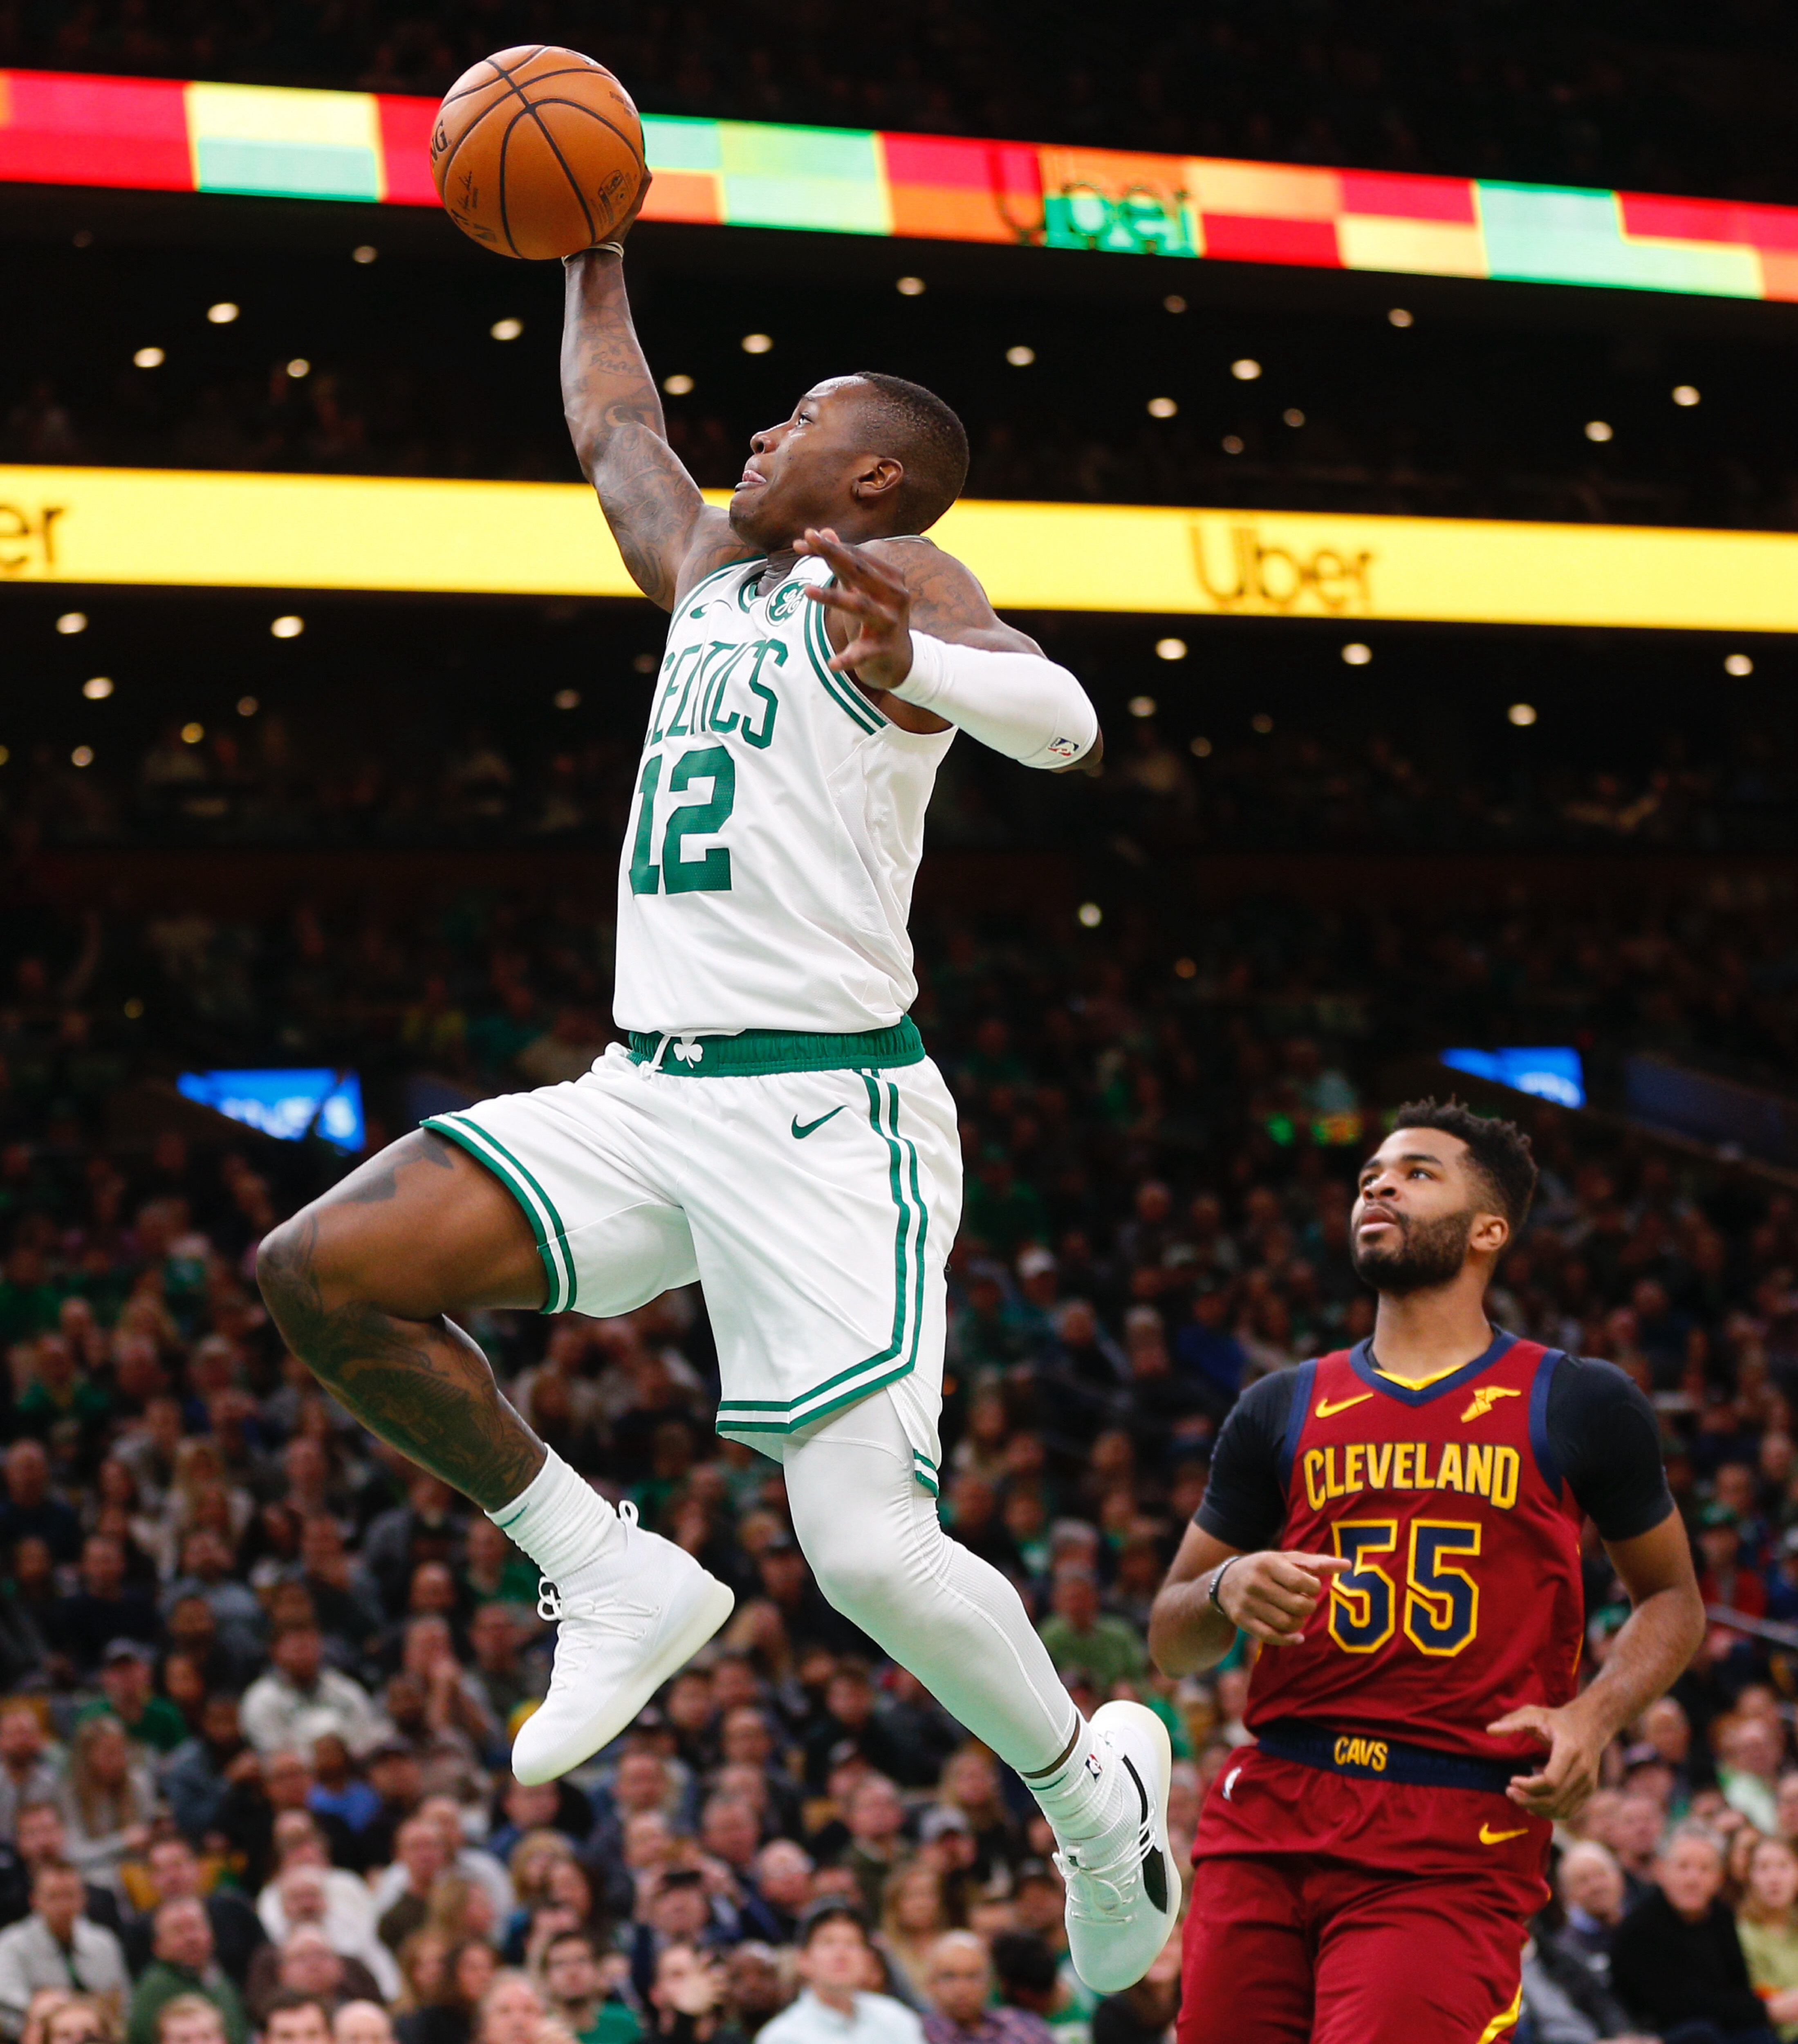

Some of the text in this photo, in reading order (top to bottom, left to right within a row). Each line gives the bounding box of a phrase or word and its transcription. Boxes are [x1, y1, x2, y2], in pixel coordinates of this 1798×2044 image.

[986, 144, 1200, 253] Uber
[1187, 523, 1372, 610] Uber
[629, 746, 735, 895] 12
[1303, 1442, 1521, 1512] CLEVELAND
[1328, 1519, 1482, 1658] 55
[1333, 1735, 1389, 1773] CAVS
